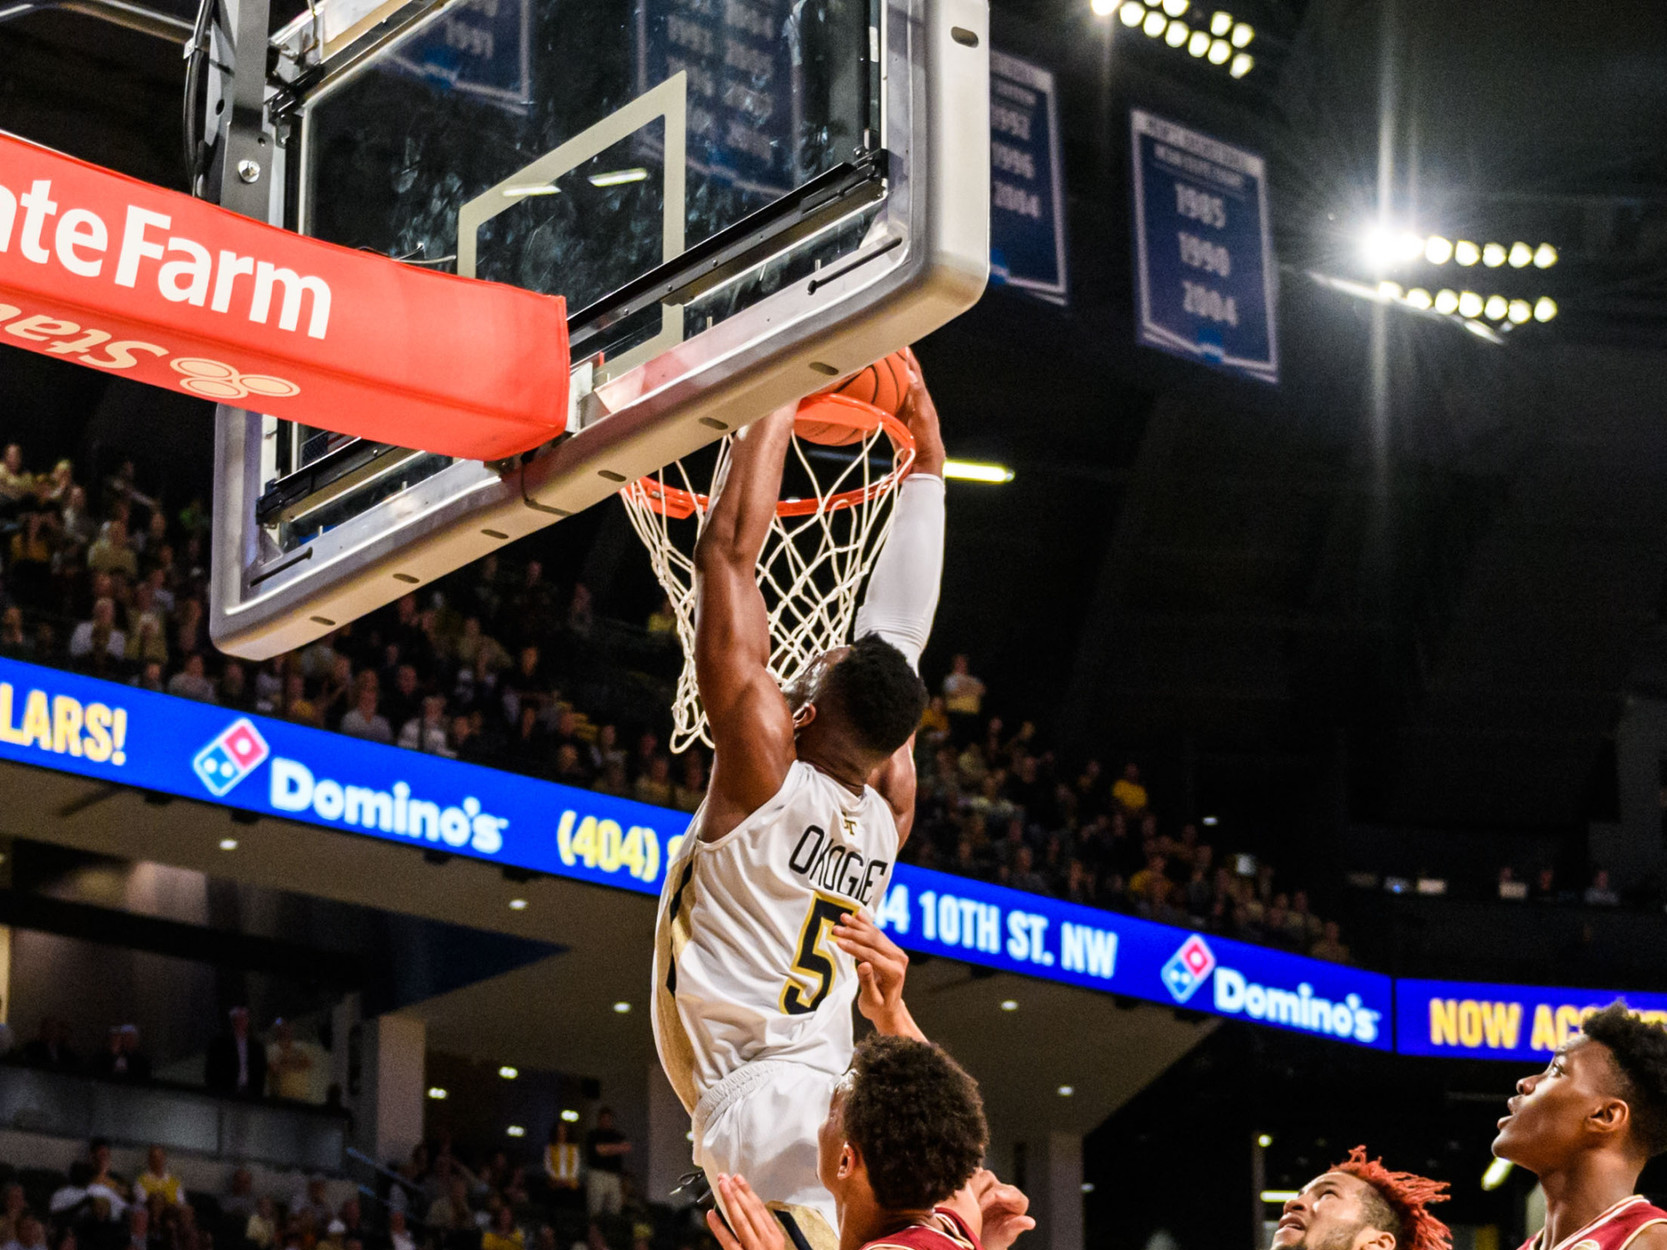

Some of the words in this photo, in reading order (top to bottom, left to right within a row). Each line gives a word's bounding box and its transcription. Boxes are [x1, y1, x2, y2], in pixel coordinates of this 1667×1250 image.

[0, 303, 169, 369] Sta
[0, 682, 128, 766] LARS!
[269, 756, 508, 855] Domino's
[557, 809, 660, 883] (404)
[778, 891, 863, 1015] 5
[918, 890, 1001, 955] 10TH
[1006, 909, 1056, 967] ST.
[1060, 920, 1119, 980] NW
[1213, 966, 1383, 1044] Domino's
[1429, 997, 1522, 1050] NOW
